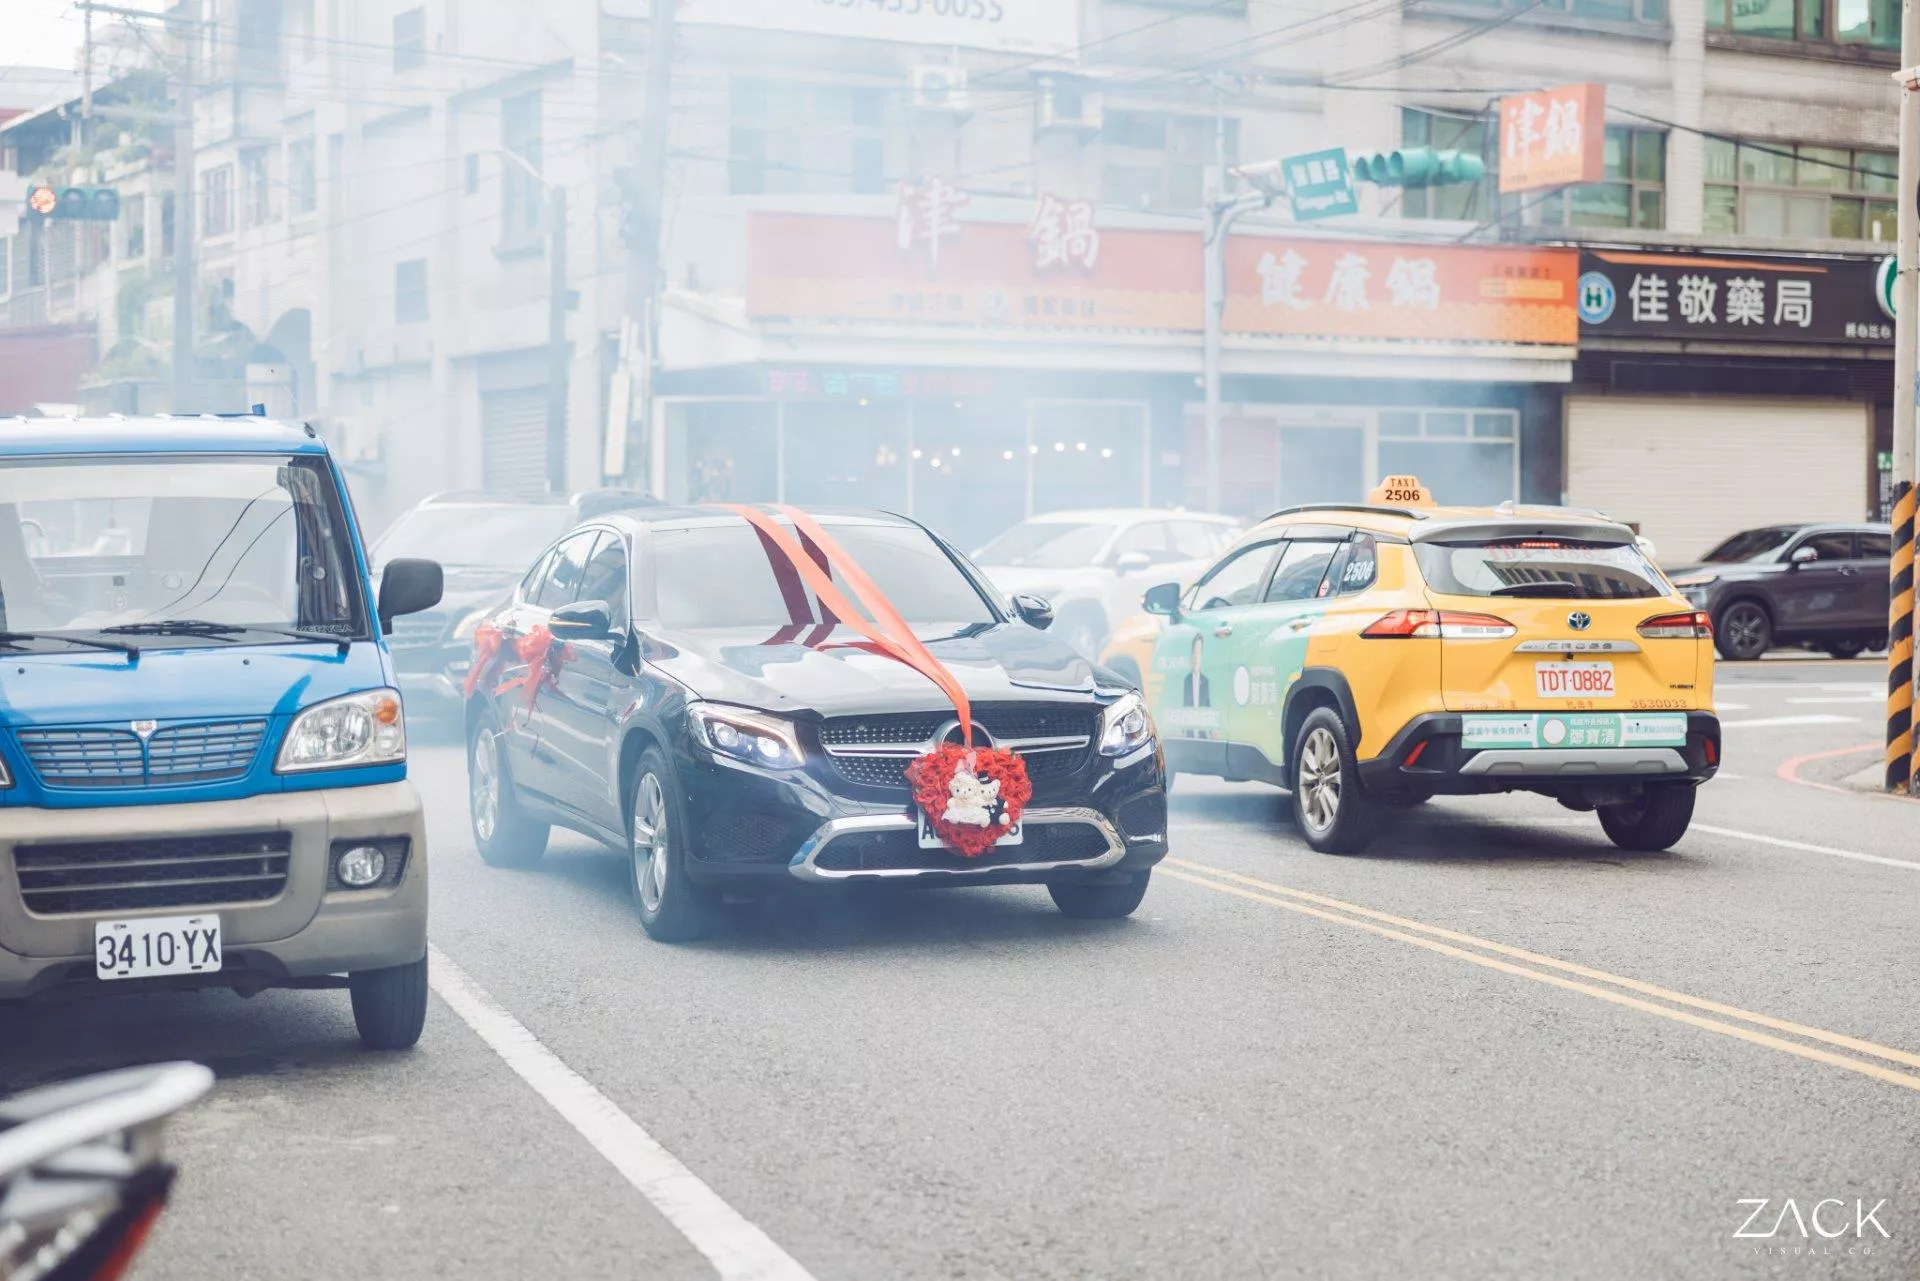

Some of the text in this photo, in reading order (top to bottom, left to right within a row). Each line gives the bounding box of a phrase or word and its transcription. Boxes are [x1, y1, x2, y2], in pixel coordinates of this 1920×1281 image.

[1506, 97, 1582, 168] 津鍋
[897, 176, 1101, 276] 津鍋
[1256, 248, 1440, 312] 健康鍋
[1629, 272, 1813, 328] 佳敬藥局
[1385, 489, 1421, 501] 2506
[1390, 478, 1415, 487] TAXI
[1343, 560, 1375, 582] 2506
[1630, 699, 1688, 709] 3630033
